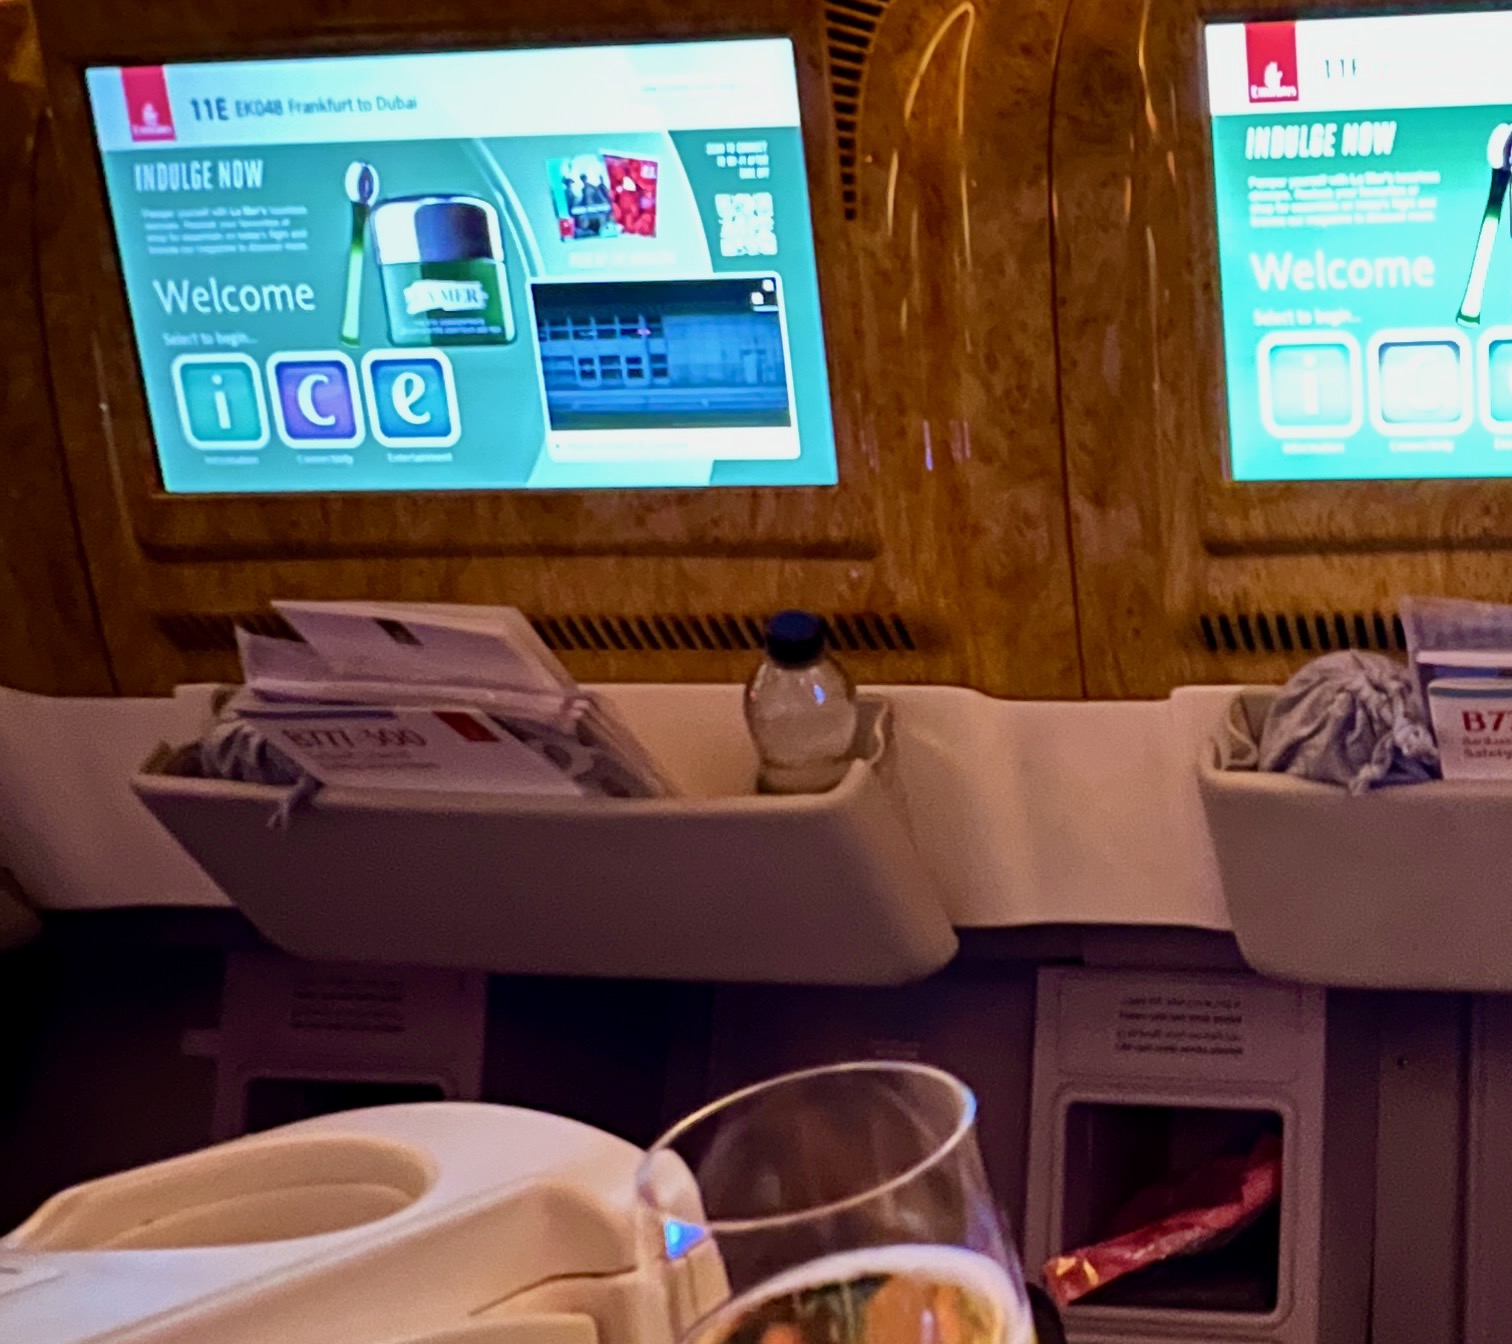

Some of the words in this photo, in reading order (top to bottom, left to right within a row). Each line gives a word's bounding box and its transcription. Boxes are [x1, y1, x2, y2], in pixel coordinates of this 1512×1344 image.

[190, 96, 229, 121] 11E
[235, 98, 284, 118] EK048
[287, 96, 354, 115] Frankfurt
[356, 97, 372, 113] to
[375, 95, 418, 112] Dubai
[1245, 122, 1338, 160] INDULGE
[1341, 120, 1398, 156] NOW
[133, 160, 214, 192] INDULGE
[217, 159, 264, 190] NOW
[1249, 249, 1436, 291] Welcome
[152, 277, 317, 315] Welcome
[162, 332, 199, 346] Select
[200, 332, 214, 346] to
[211, 373, 231, 430] i
[391, 371, 432, 425] e
